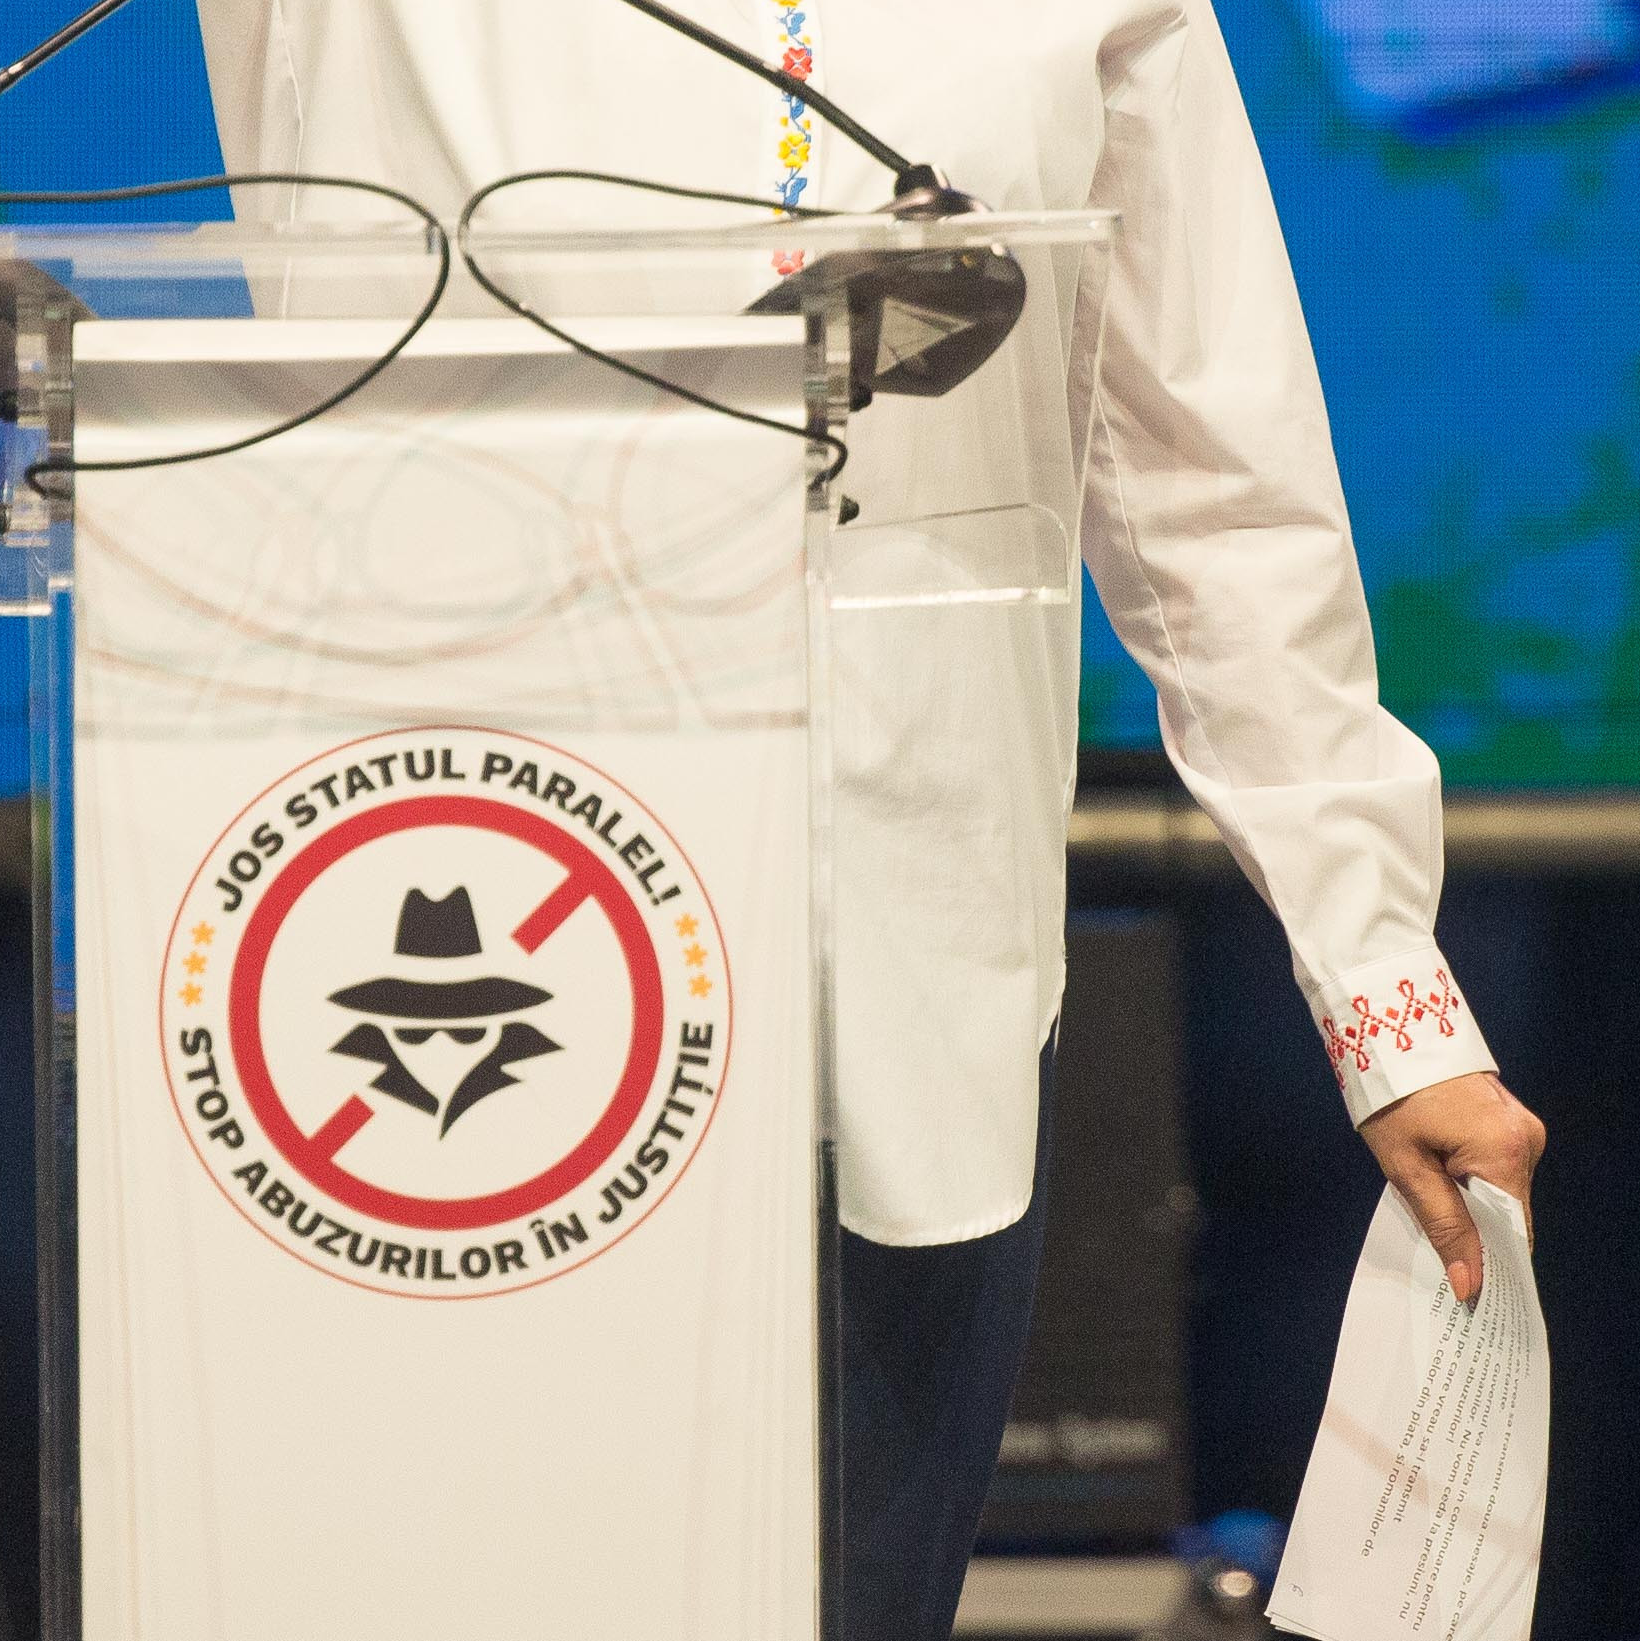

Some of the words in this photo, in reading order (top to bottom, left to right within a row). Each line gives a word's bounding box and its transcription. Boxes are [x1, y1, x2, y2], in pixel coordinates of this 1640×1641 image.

[216, 823, 283, 911] JOS
[286, 749, 465, 827] STATUL
[481, 753, 680, 905] PARALEL!
[181, 1028, 244, 1148] STOP
[234, 1162, 528, 1280] ABUZURILOR
[530, 1213, 588, 1259] ÎN
[599, 1023, 713, 1223] JUSTIȚIE
[1439, 1300, 1463, 1344] oastra,
[1427, 1349, 1444, 1384] celor
[1455, 1340, 1465, 1358] pe
[1442, 1362, 1457, 1391] care
[1467, 1353, 1491, 1423] romanilor.
[1416, 1387, 1431, 1408] din
[1446, 1367, 1475, 1443] abuzurilor!
[1481, 1363, 1500, 1428] Guvernul
[1399, 1411, 1420, 1449] piata,
[1426, 1396, 1446, 1433] vreau
[1416, 1437, 1430, 1462] sa-l
[1460, 1429, 1472, 1449] Nu
[1475, 1431, 1484, 1446] va
[1395, 1453, 1405, 1466] si
[1448, 1453, 1463, 1482] vom
[1463, 1450, 1480, 1486] lupta
[1493, 1432, 1511, 1490] transmit
[1370, 1468, 1399, 1537] romanilor
[1393, 1465, 1421, 1522] transmit
[1435, 1486, 1451, 1519] ceda
[1457, 1490, 1467, 1502] in
[1429, 1523, 1441, 1534] la
[1481, 1494, 1496, 1529] doua
[1361, 1539, 1374, 1556] de
[1430, 1506, 1460, 1581] continuare
[1463, 1534, 1484, 1585] mesaje,
[1406, 1538, 1433, 1596] presiuni,
[1399, 1601, 1410, 1619] nu
[1413, 1584, 1434, 1631] pentru
[1457, 1590, 1467, 1608] pe
[1444, 1611, 1460, 1641] care
